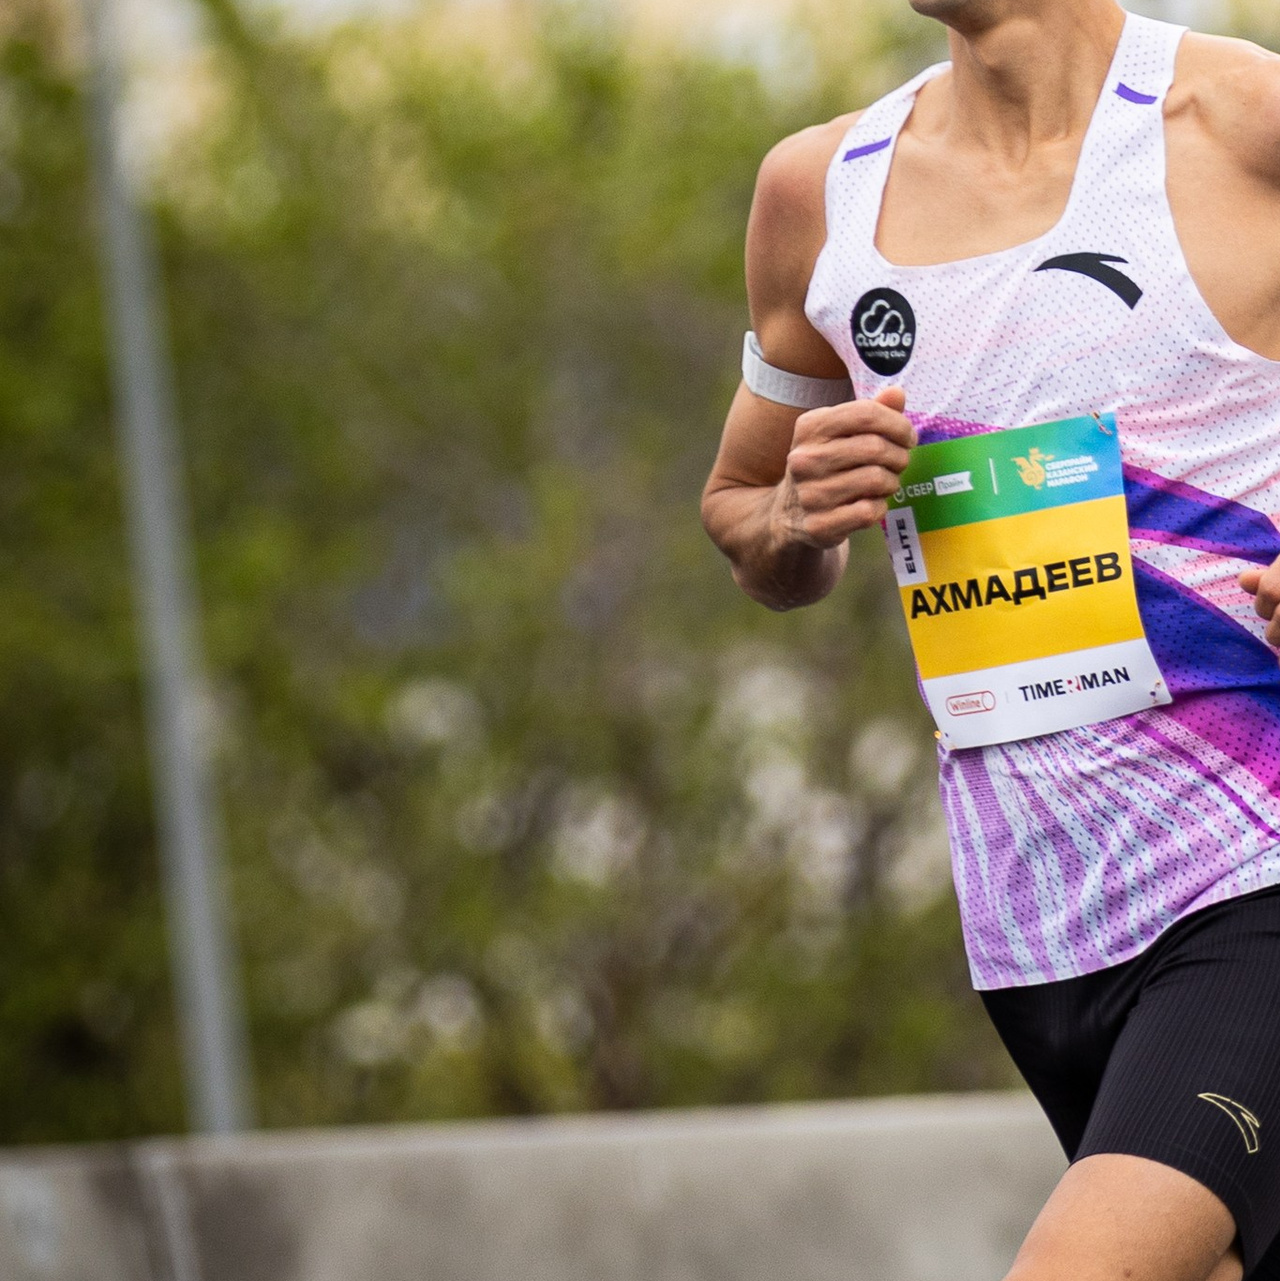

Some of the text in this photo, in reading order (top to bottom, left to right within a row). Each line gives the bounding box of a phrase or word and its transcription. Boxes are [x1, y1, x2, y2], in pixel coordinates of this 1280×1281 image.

[906, 482, 933, 498] СБЕР
[895, 518, 917, 574] ELITE
[911, 551, 1122, 619] АХМАДЕЕВ
